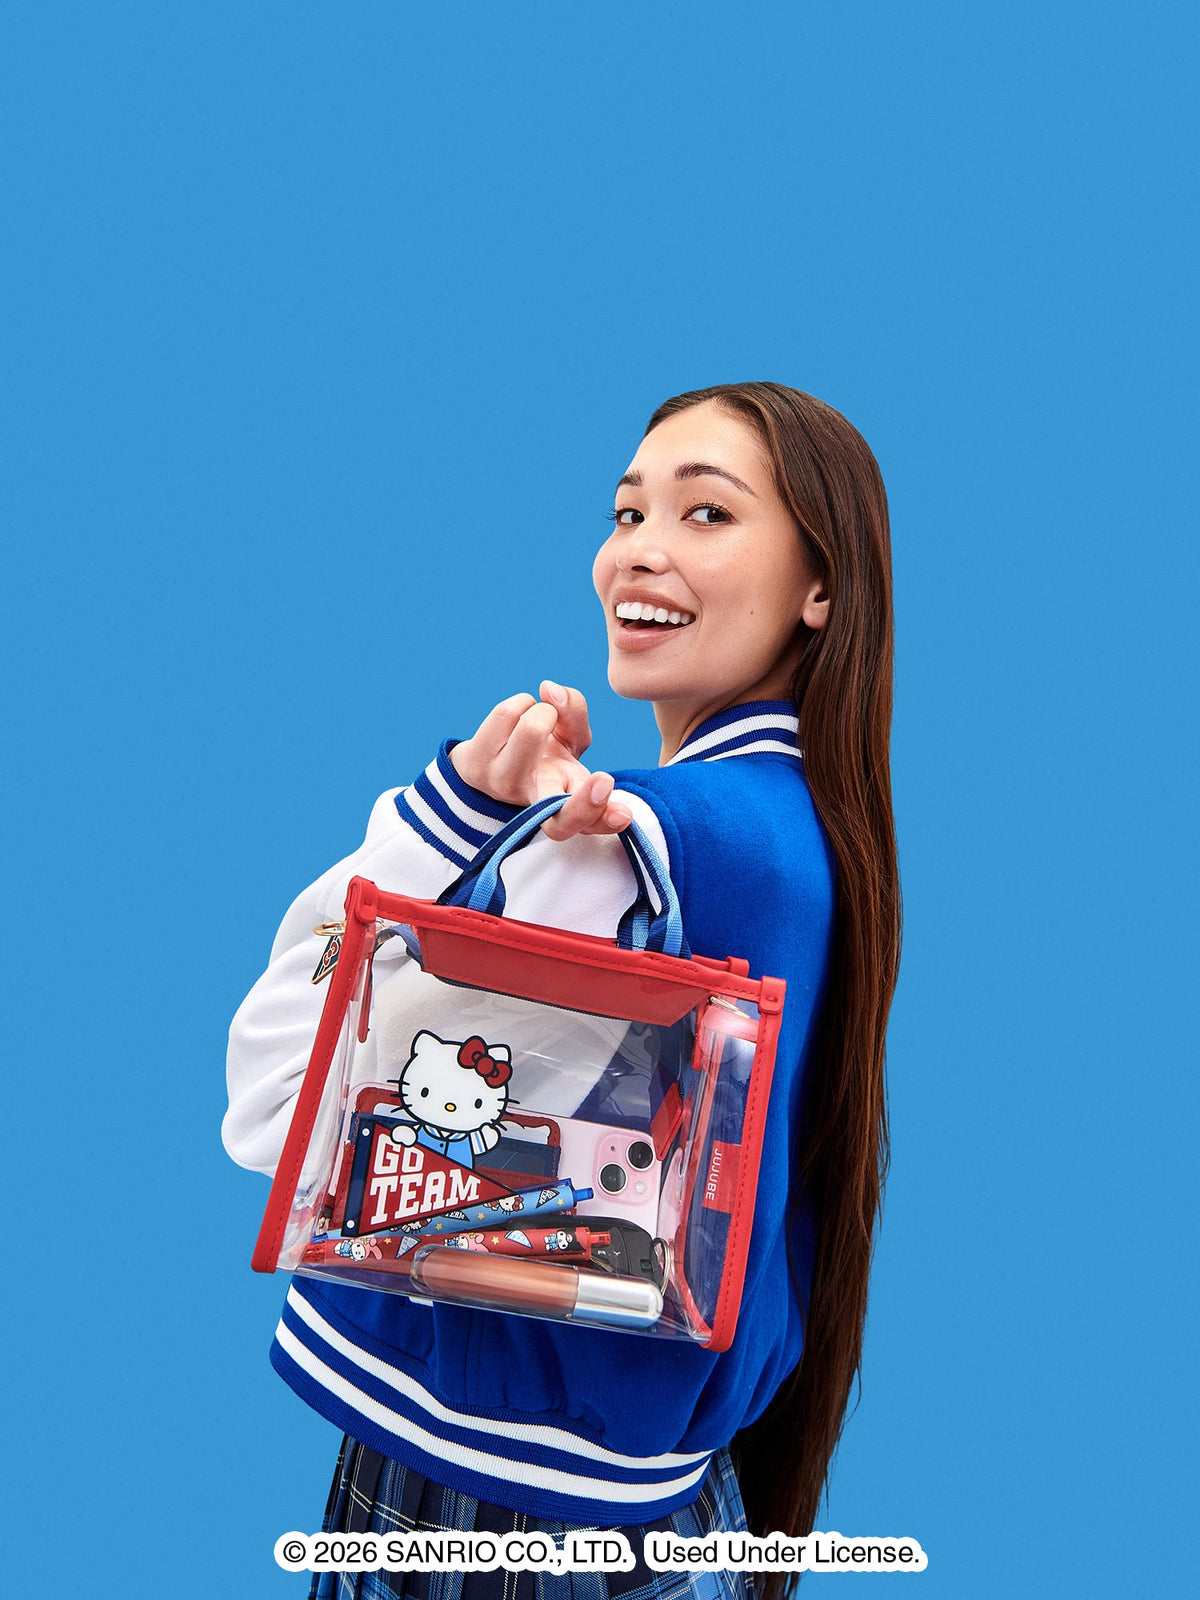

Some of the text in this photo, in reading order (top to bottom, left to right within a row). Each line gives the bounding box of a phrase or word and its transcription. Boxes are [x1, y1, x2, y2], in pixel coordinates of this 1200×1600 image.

[373, 1133, 425, 1175] GO
[705, 1148, 723, 1201] JUJUBE
[369, 1168, 481, 1226] TEAM
